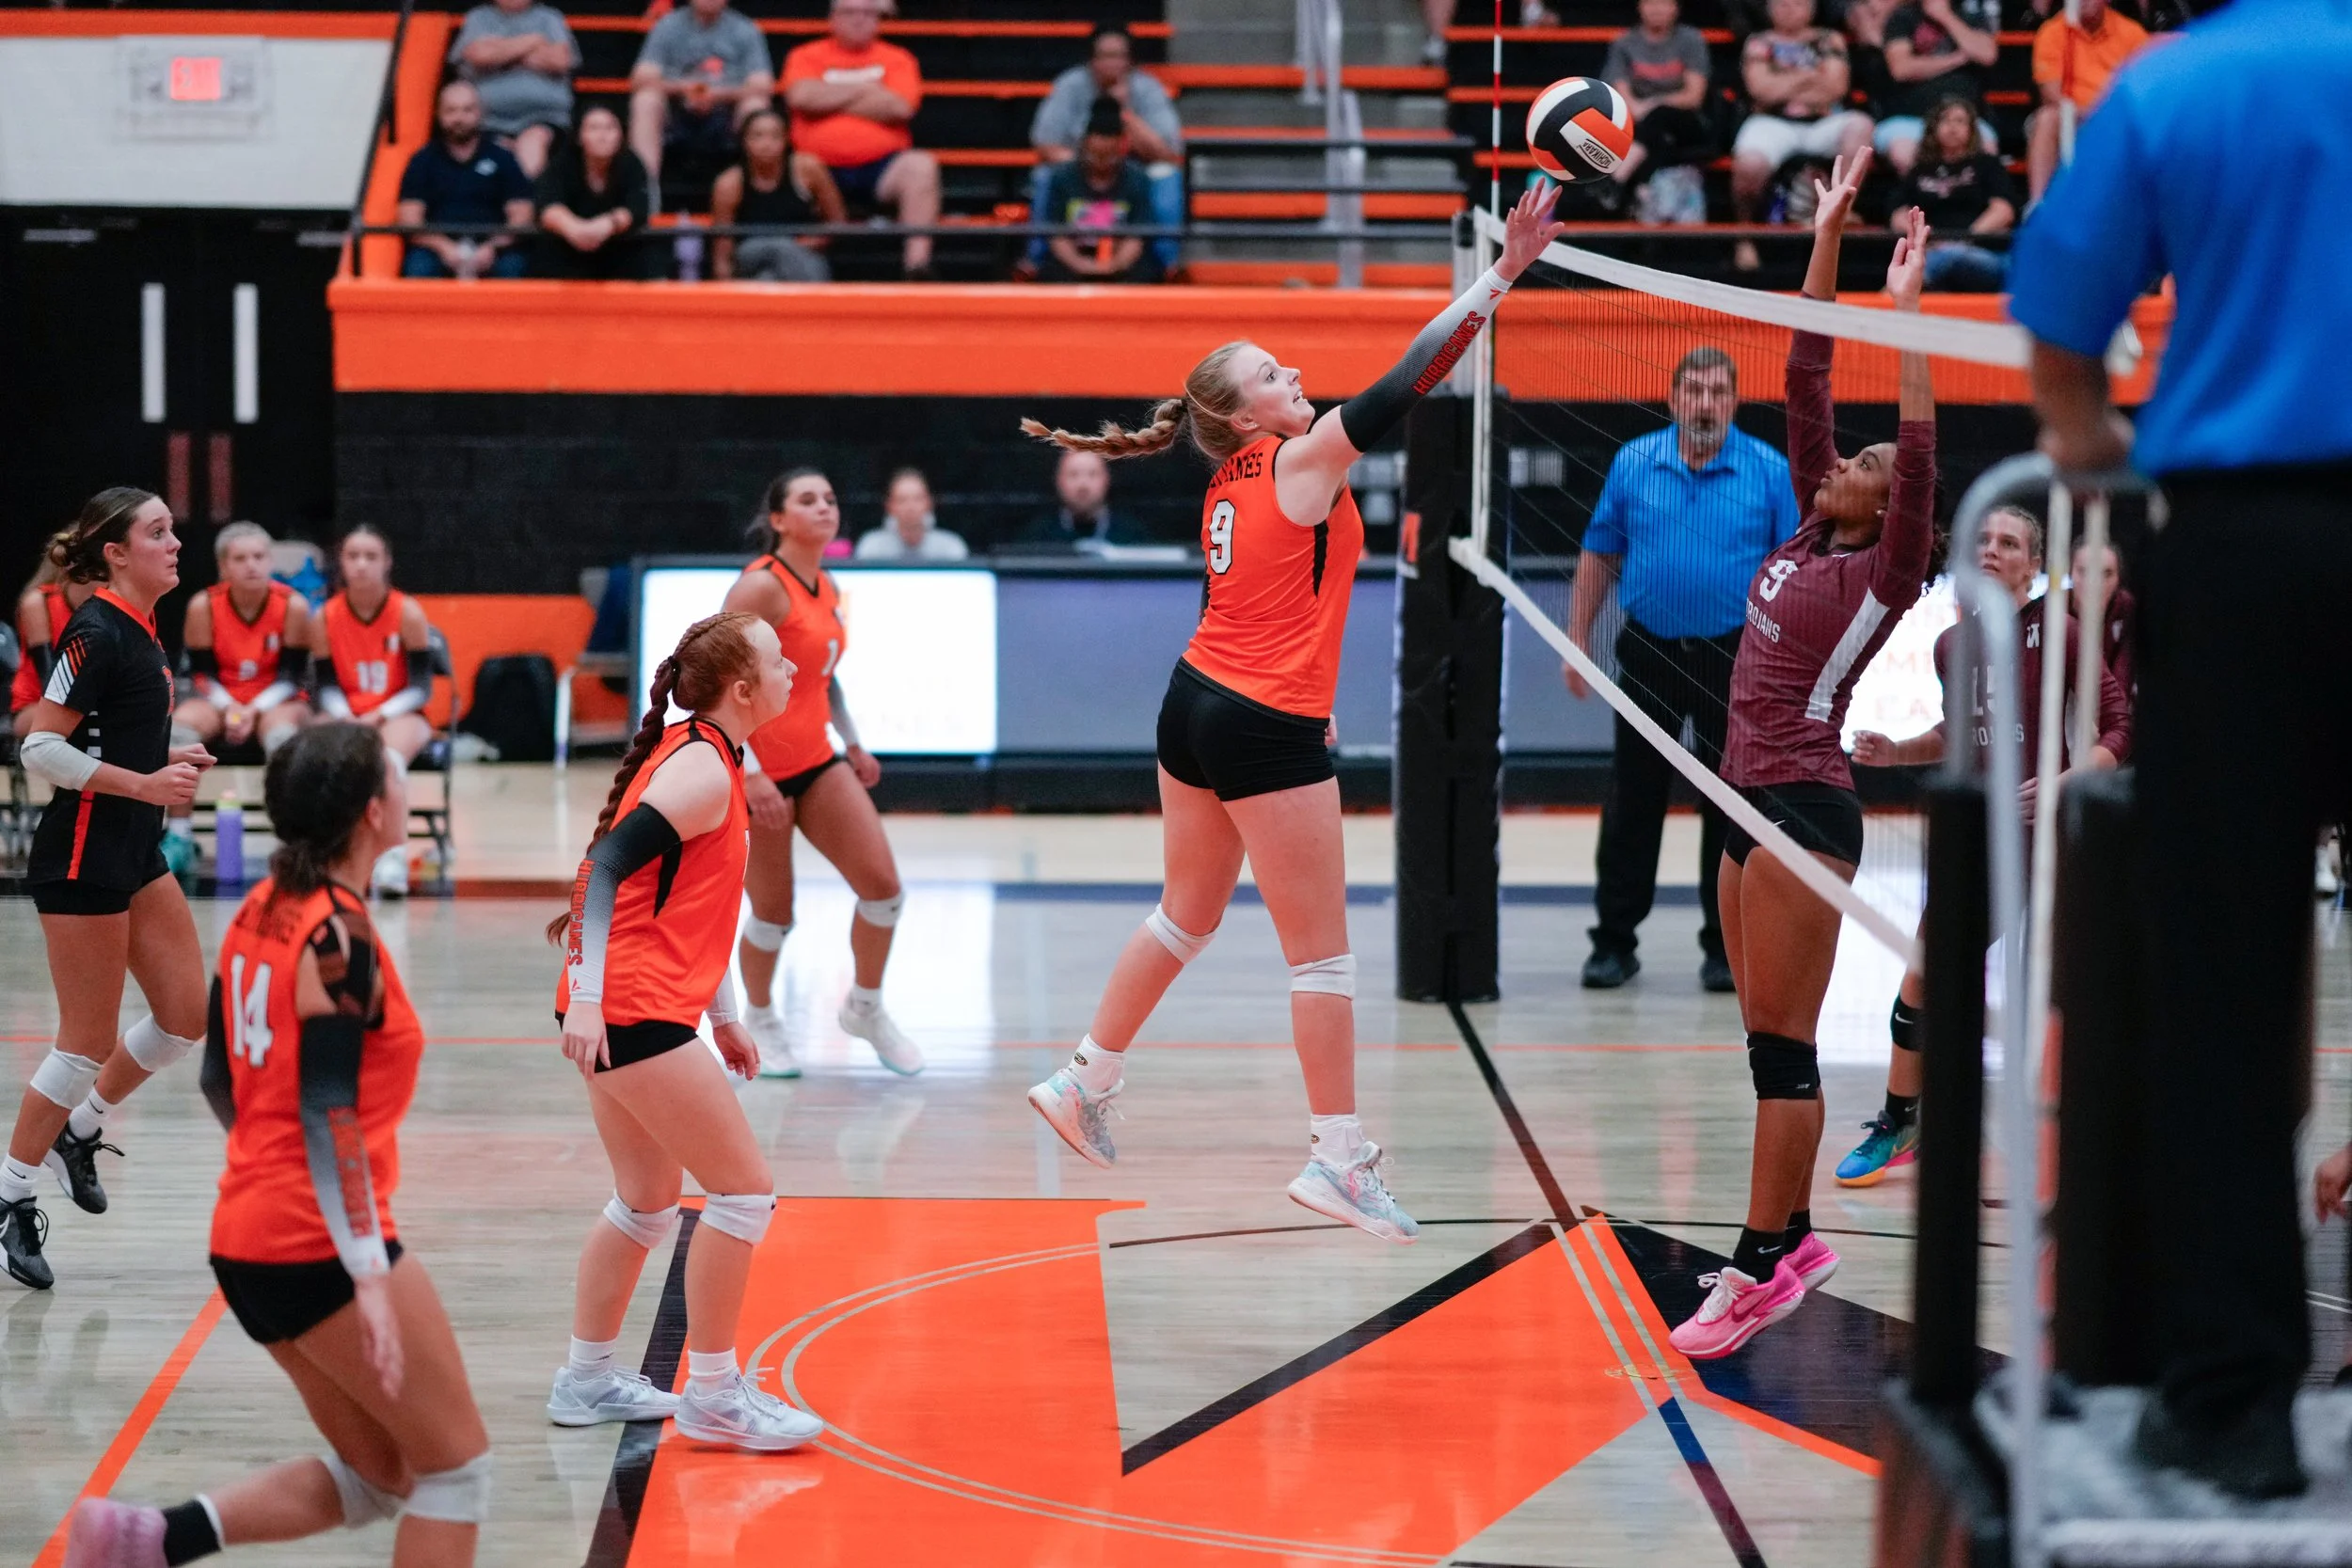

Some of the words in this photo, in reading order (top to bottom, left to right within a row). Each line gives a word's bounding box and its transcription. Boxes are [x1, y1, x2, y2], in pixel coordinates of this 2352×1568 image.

[1581, 142, 1613, 167] TACHIKARA
[1411, 310, 1486, 395] HURRICANES
[1208, 499, 1236, 576] 9
[1759, 559, 1799, 602] 9
[567, 858, 596, 967] HURRICANES
[230, 953, 273, 1068] 14
